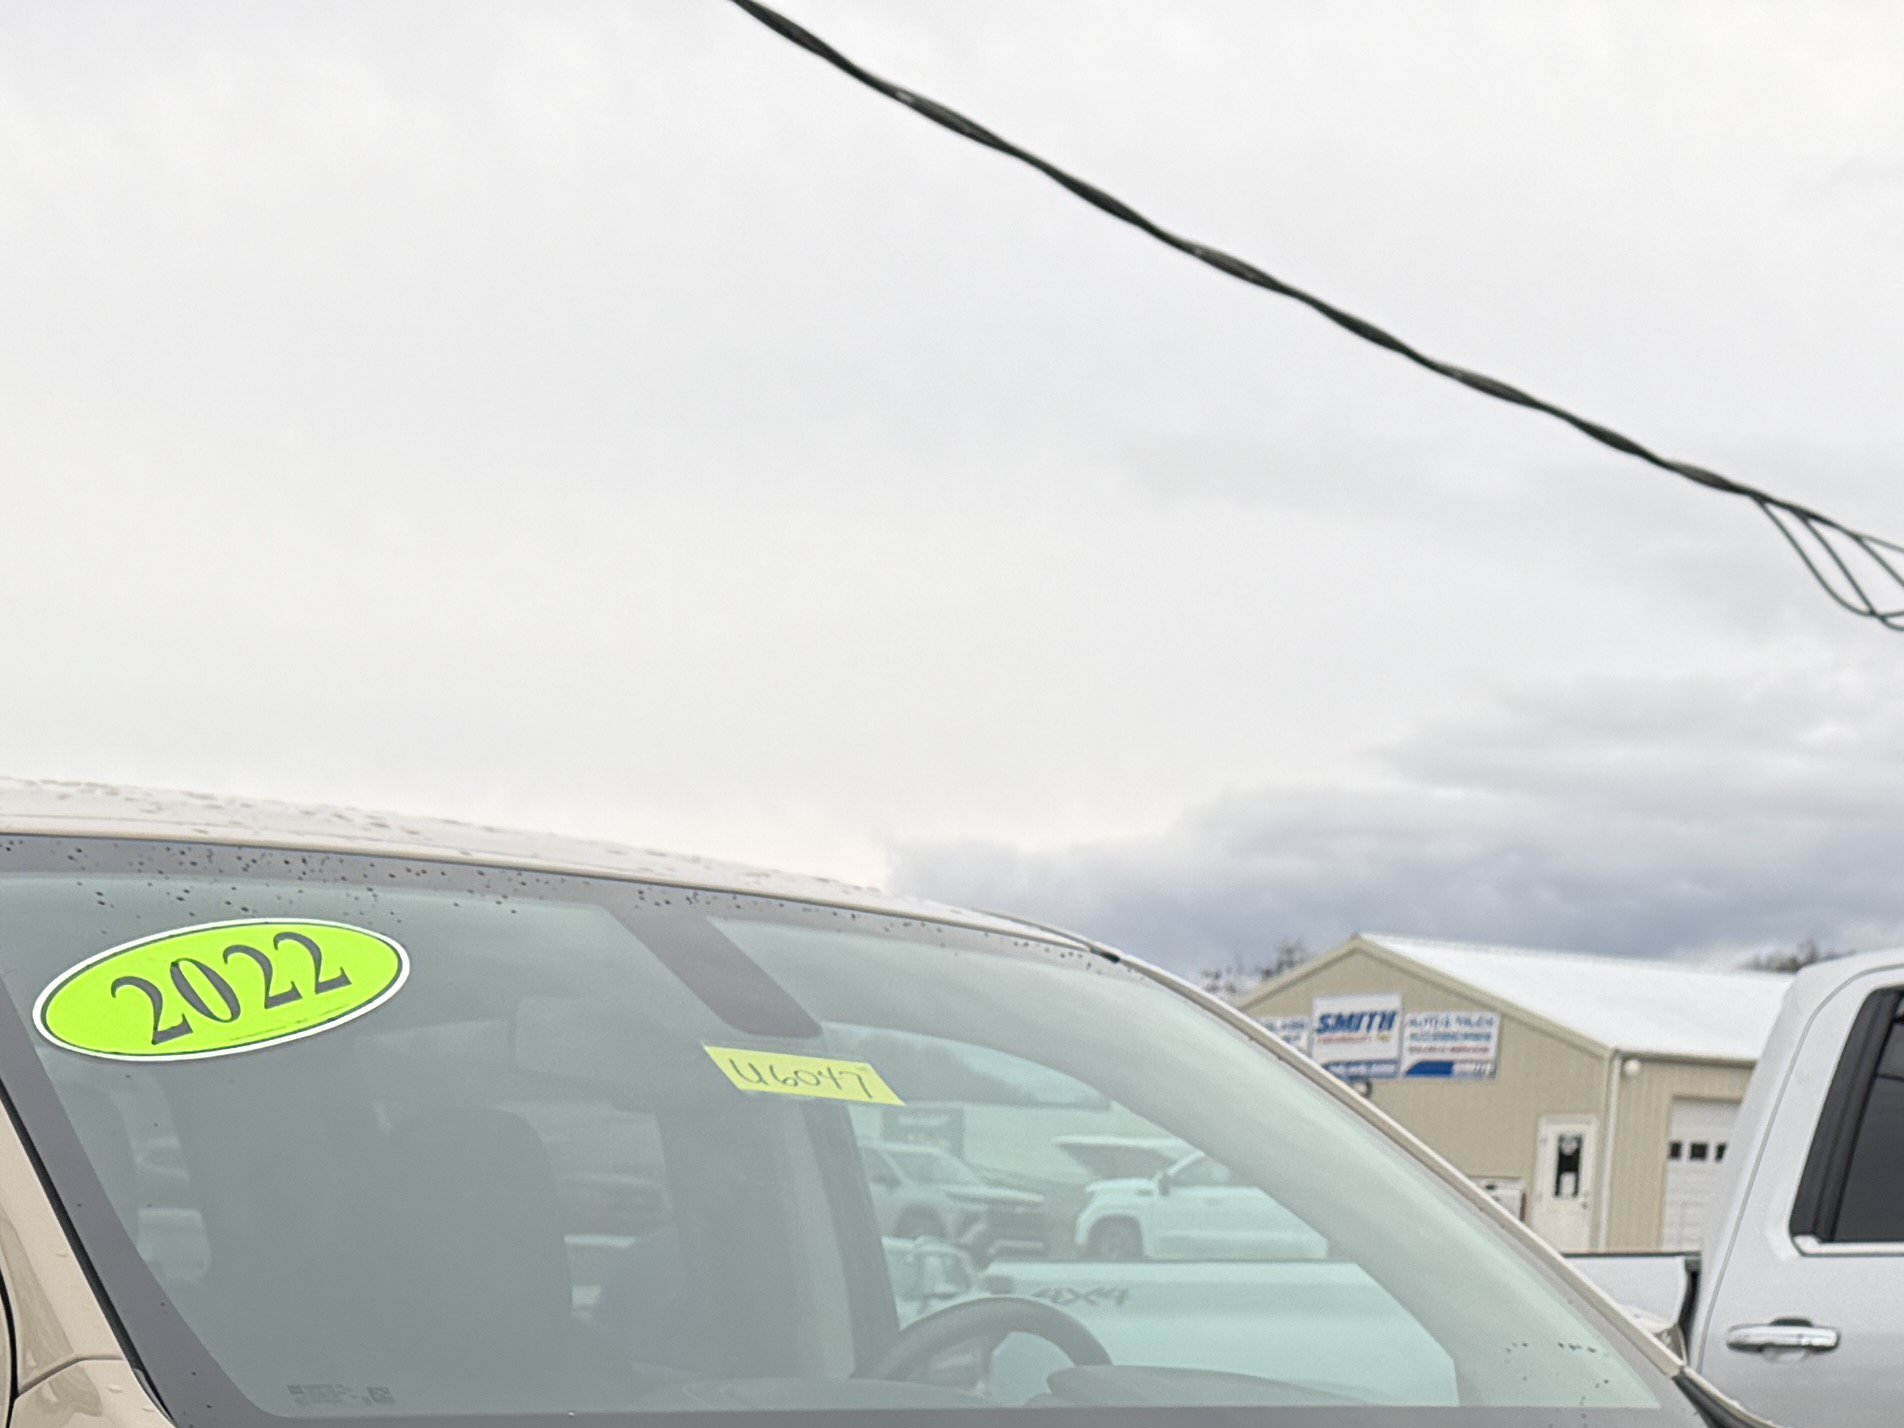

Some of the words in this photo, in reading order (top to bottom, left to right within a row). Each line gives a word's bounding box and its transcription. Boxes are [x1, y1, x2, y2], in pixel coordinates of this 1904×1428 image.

[110, 931, 353, 1046] 2022
[1316, 1010, 1398, 1034] SMITH
[728, 1057, 874, 1099] U6047
